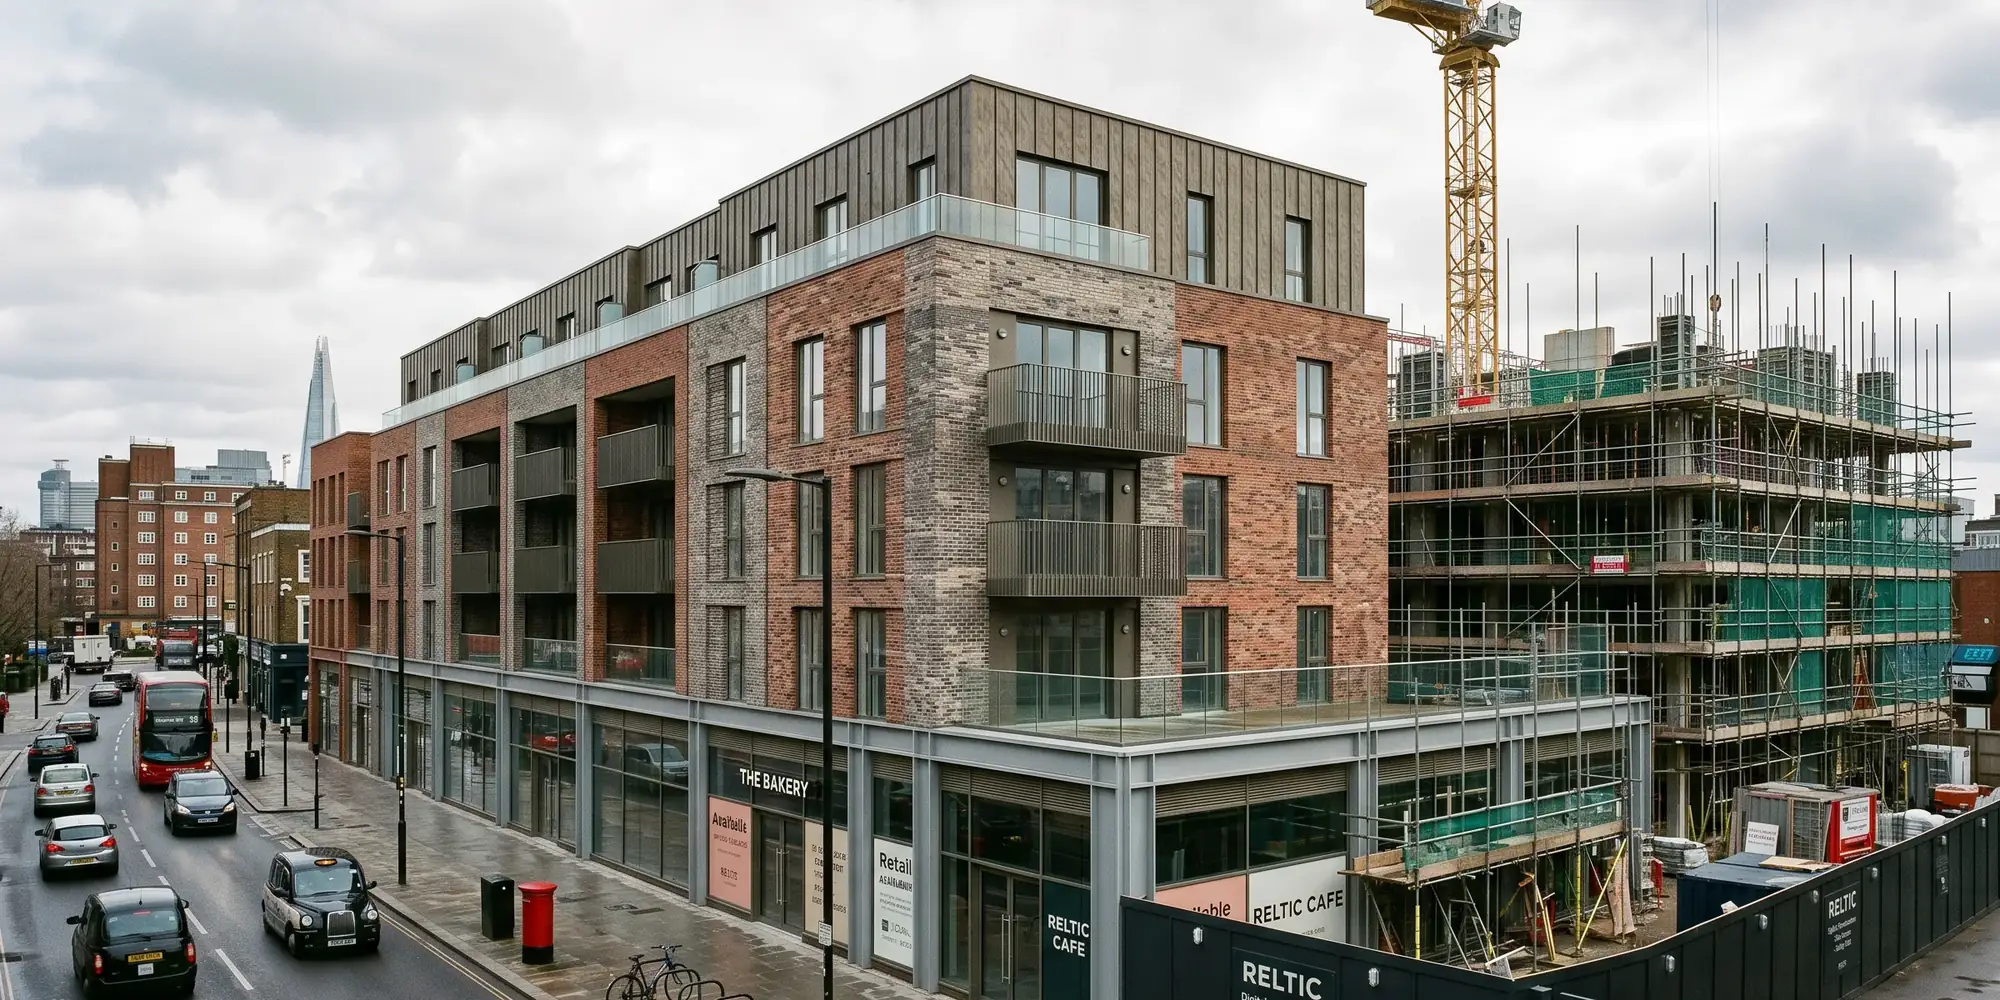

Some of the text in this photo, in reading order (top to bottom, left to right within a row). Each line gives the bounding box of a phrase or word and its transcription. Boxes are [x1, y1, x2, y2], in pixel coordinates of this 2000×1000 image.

[740, 768, 809, 798] THE BAKERY
[879, 852, 912, 875] Retail
[1253, 889, 1343, 924] RELTIC CAFE
[1828, 890, 1857, 919] RELTIC
[1047, 914, 1090, 938] RELTIC
[1052, 935, 1086, 958] CAFE
[1243, 960, 1322, 1000] RELTIC
